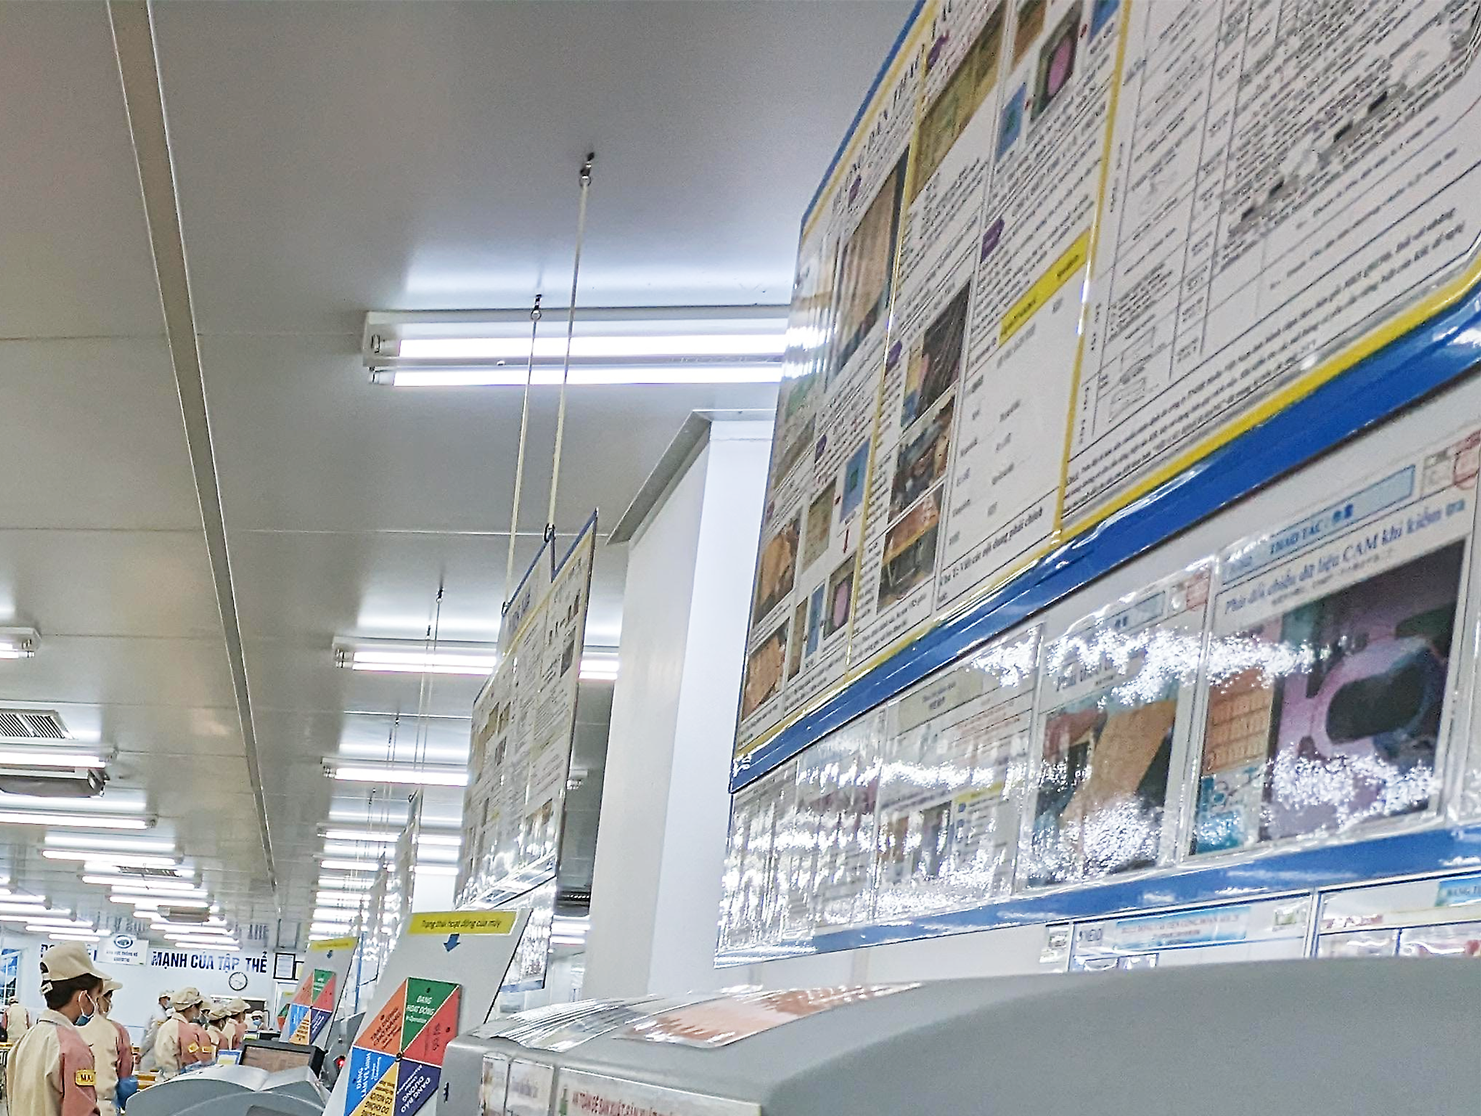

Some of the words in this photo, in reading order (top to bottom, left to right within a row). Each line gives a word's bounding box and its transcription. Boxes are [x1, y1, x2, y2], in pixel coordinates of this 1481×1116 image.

[1342, 533, 1378, 561] CAM
[151, 951, 188, 970] MẠNH
[245, 950, 268, 974] THỂ
